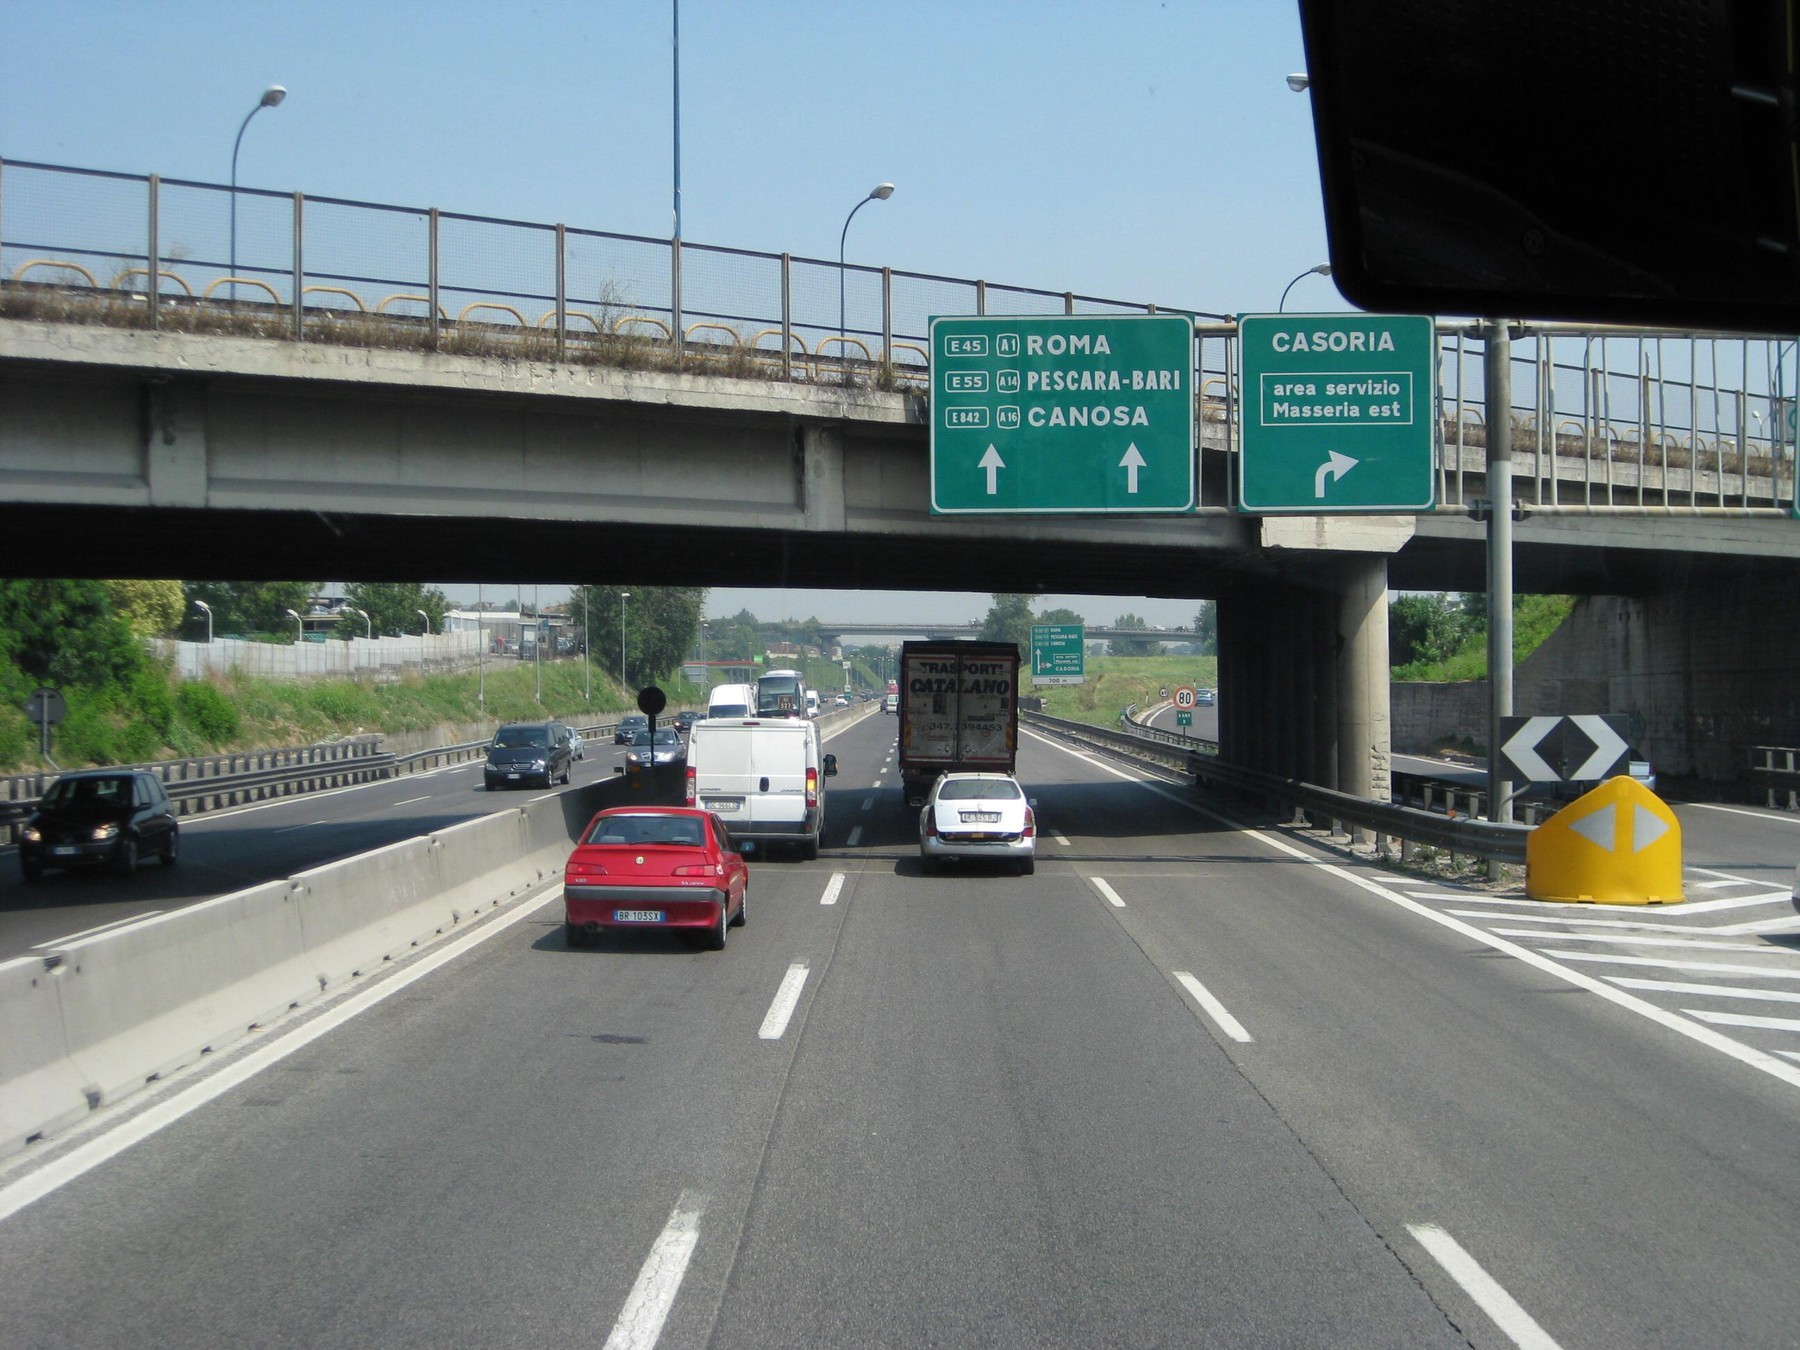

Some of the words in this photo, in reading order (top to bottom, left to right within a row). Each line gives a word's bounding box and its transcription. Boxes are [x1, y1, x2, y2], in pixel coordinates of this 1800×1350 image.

[1027, 334, 1112, 356] ROMA
[1272, 331, 1395, 352] CASORIA
[1027, 369, 1181, 391] PESCARA-BARI
[1273, 383, 1317, 396] area
[1325, 379, 1400, 396] servizio
[1027, 405, 1150, 427] CANOSA
[1273, 401, 1361, 418] Masseria
[1368, 401, 1401, 417] est
[910, 678, 1010, 695] CATALANO
[1178, 691, 1191, 705] 80
